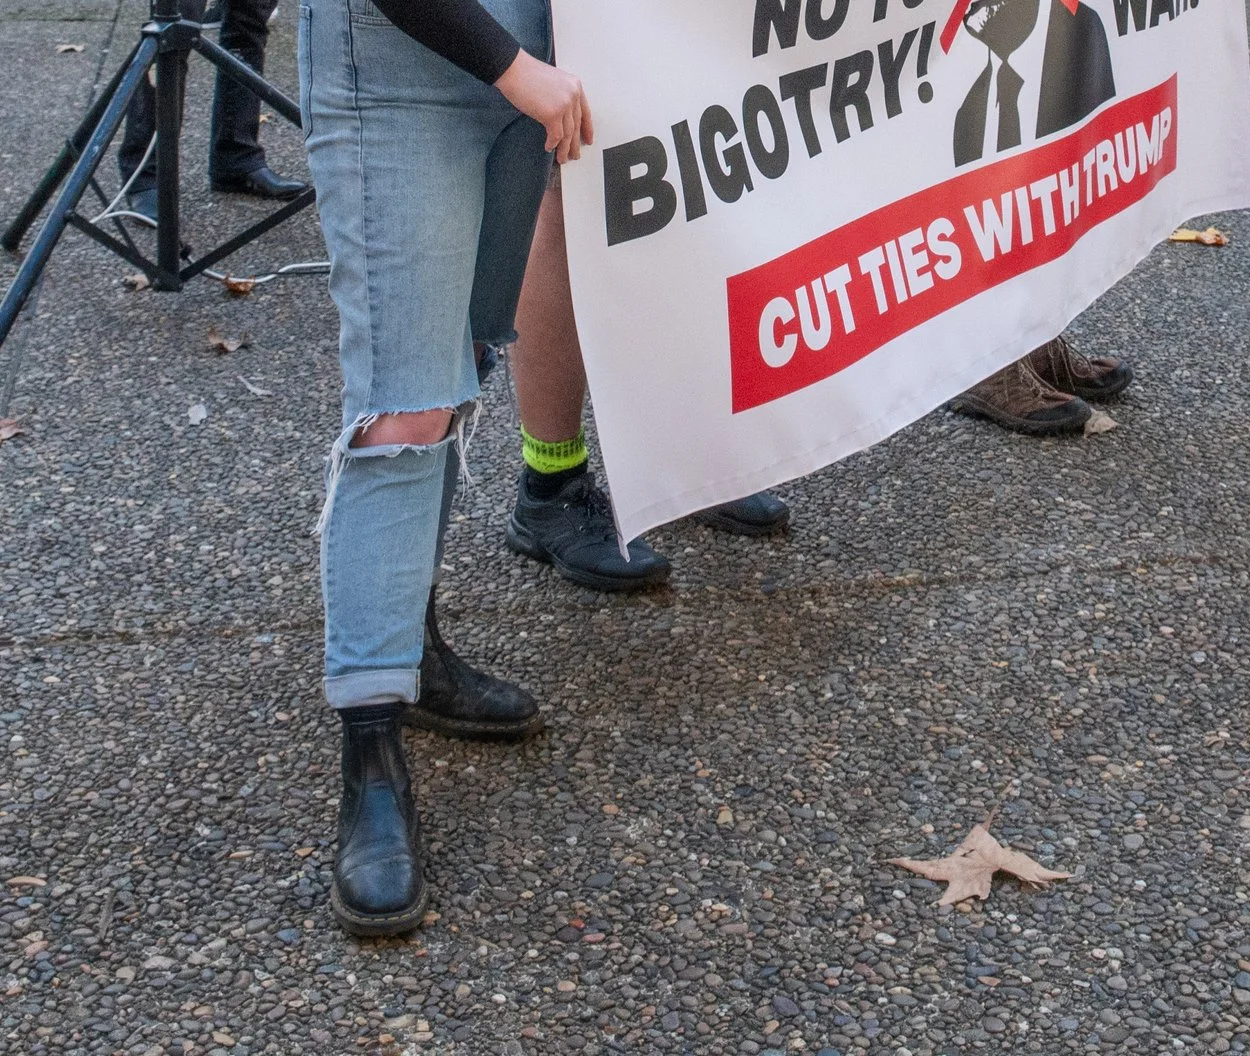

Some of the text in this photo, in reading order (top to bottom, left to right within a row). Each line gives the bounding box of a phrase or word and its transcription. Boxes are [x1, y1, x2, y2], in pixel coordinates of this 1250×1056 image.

[602, 20, 937, 248] BIGOTRY!
[758, 106, 1172, 369] CUT TIES WITH TRUMP
